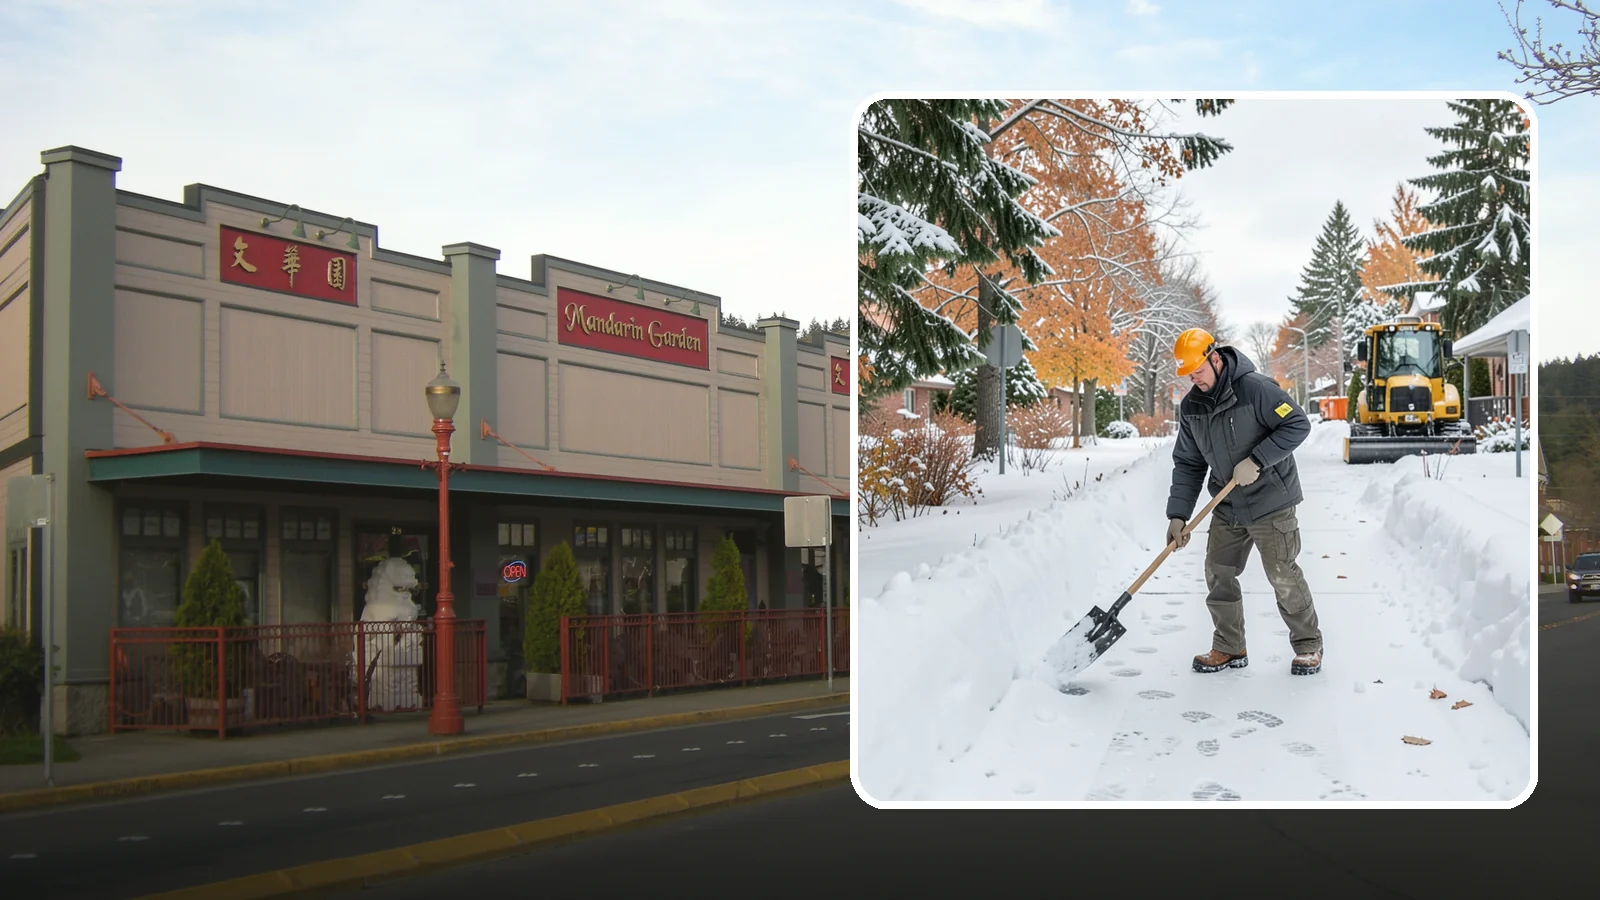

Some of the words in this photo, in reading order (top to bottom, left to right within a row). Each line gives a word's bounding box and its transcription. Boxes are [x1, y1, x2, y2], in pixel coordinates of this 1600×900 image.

[231, 235, 346, 291] 文華園
[564, 302, 644, 341] Mandarin
[647, 320, 702, 352] Garden
[503, 565, 527, 578] OPEN
